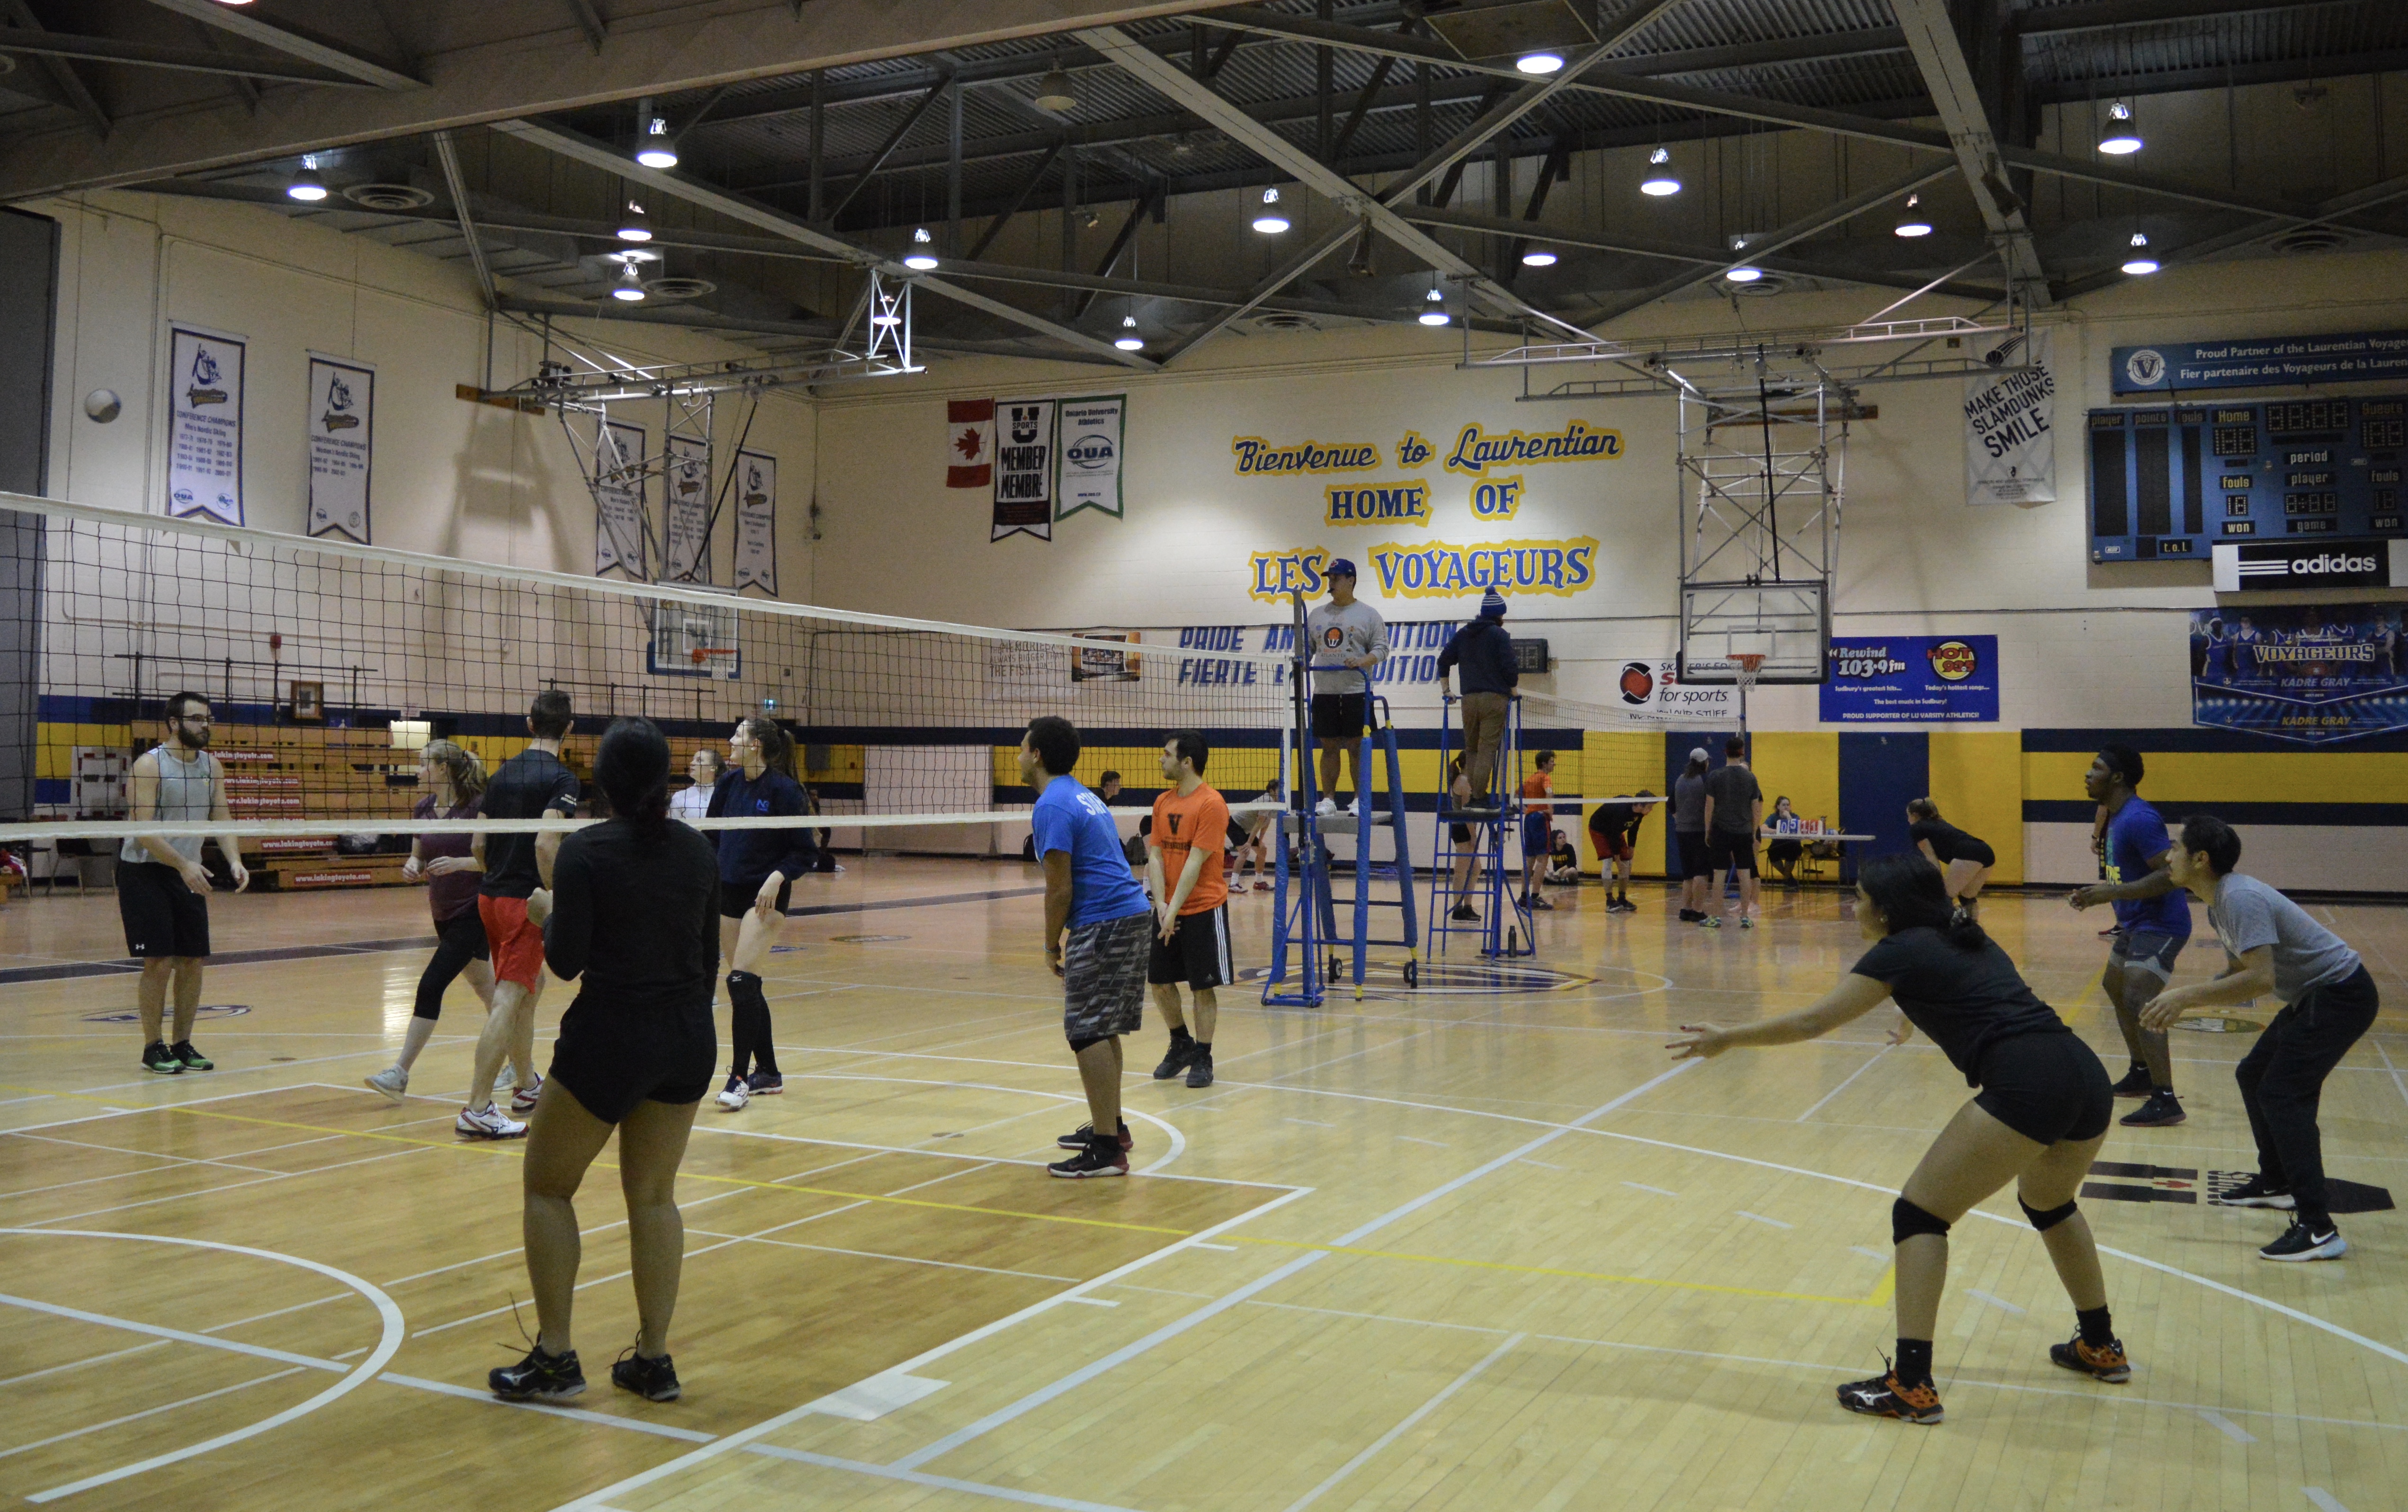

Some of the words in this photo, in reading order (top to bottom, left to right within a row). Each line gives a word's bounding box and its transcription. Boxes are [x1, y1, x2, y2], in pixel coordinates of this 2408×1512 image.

[2196, 348, 2227, 358] Proud
[2231, 346, 2270, 356] Partner
[2274, 344, 2284, 354] of
[2287, 343, 2304, 353] the
[2308, 340, 2366, 352] Laurentian
[2181, 369, 2201, 378] Fier
[2204, 366, 2258, 380] partenaire
[2262, 364, 2280, 374] des
[2283, 363, 2337, 375] Voyageurs
[2340, 360, 2353, 369] de
[2357, 359, 2366, 368] la
[1963, 385, 2005, 419] MAKE
[2001, 360, 2049, 396] THOSE
[1088, 408, 1118, 416] University
[1973, 377, 2054, 435] SLAMDUNKS
[2092, 415, 2122, 426] player
[2135, 413, 2166, 425] points
[2219, 410, 2249, 422] Home
[1012, 421, 1038, 429] SPORTS
[1984, 407, 2050, 457] SMILE
[1067, 447, 1113, 459] OUA
[1234, 439, 1376, 473] Bienvenue
[1400, 436, 1431, 464] to
[1448, 425, 1620, 471] Laurentian
[2291, 451, 2327, 465] period
[2223, 476, 2249, 488] fouls
[2292, 473, 2328, 486] player
[2372, 470, 2399, 482] fouls
[1330, 486, 1426, 520] HOME
[1475, 481, 1519, 515] OF
[2228, 522, 2249, 533] won
[2297, 521, 2326, 533] game
[2375, 518, 2398, 528] won
[2292, 553, 2377, 574] adidas
[1254, 554, 1323, 595] LES
[1374, 546, 1591, 590] VOYAGEURS
[1180, 626, 1246, 651] PRIDE
[1263, 624, 1295, 650] AN
[1019, 653, 1045, 662] BIGGER
[1839, 647, 1886, 658] Rewind
[1926, 647, 1972, 660] HOT
[2253, 644, 2375, 663] VOYAGEURS
[990, 665, 1007, 677] THE
[1889, 659, 1905, 673] fm
[2281, 678, 2318, 687] KADRE
[2319, 677, 2351, 687] GRAY
[1659, 687, 1681, 702] for
[1682, 689, 1728, 705] sports
[2282, 716, 2319, 725] KADRE
[2321, 716, 2352, 725] GRAY
[1167, 813, 1183, 836] V
[295, 873, 371, 882] www.lakingtoyota.com
